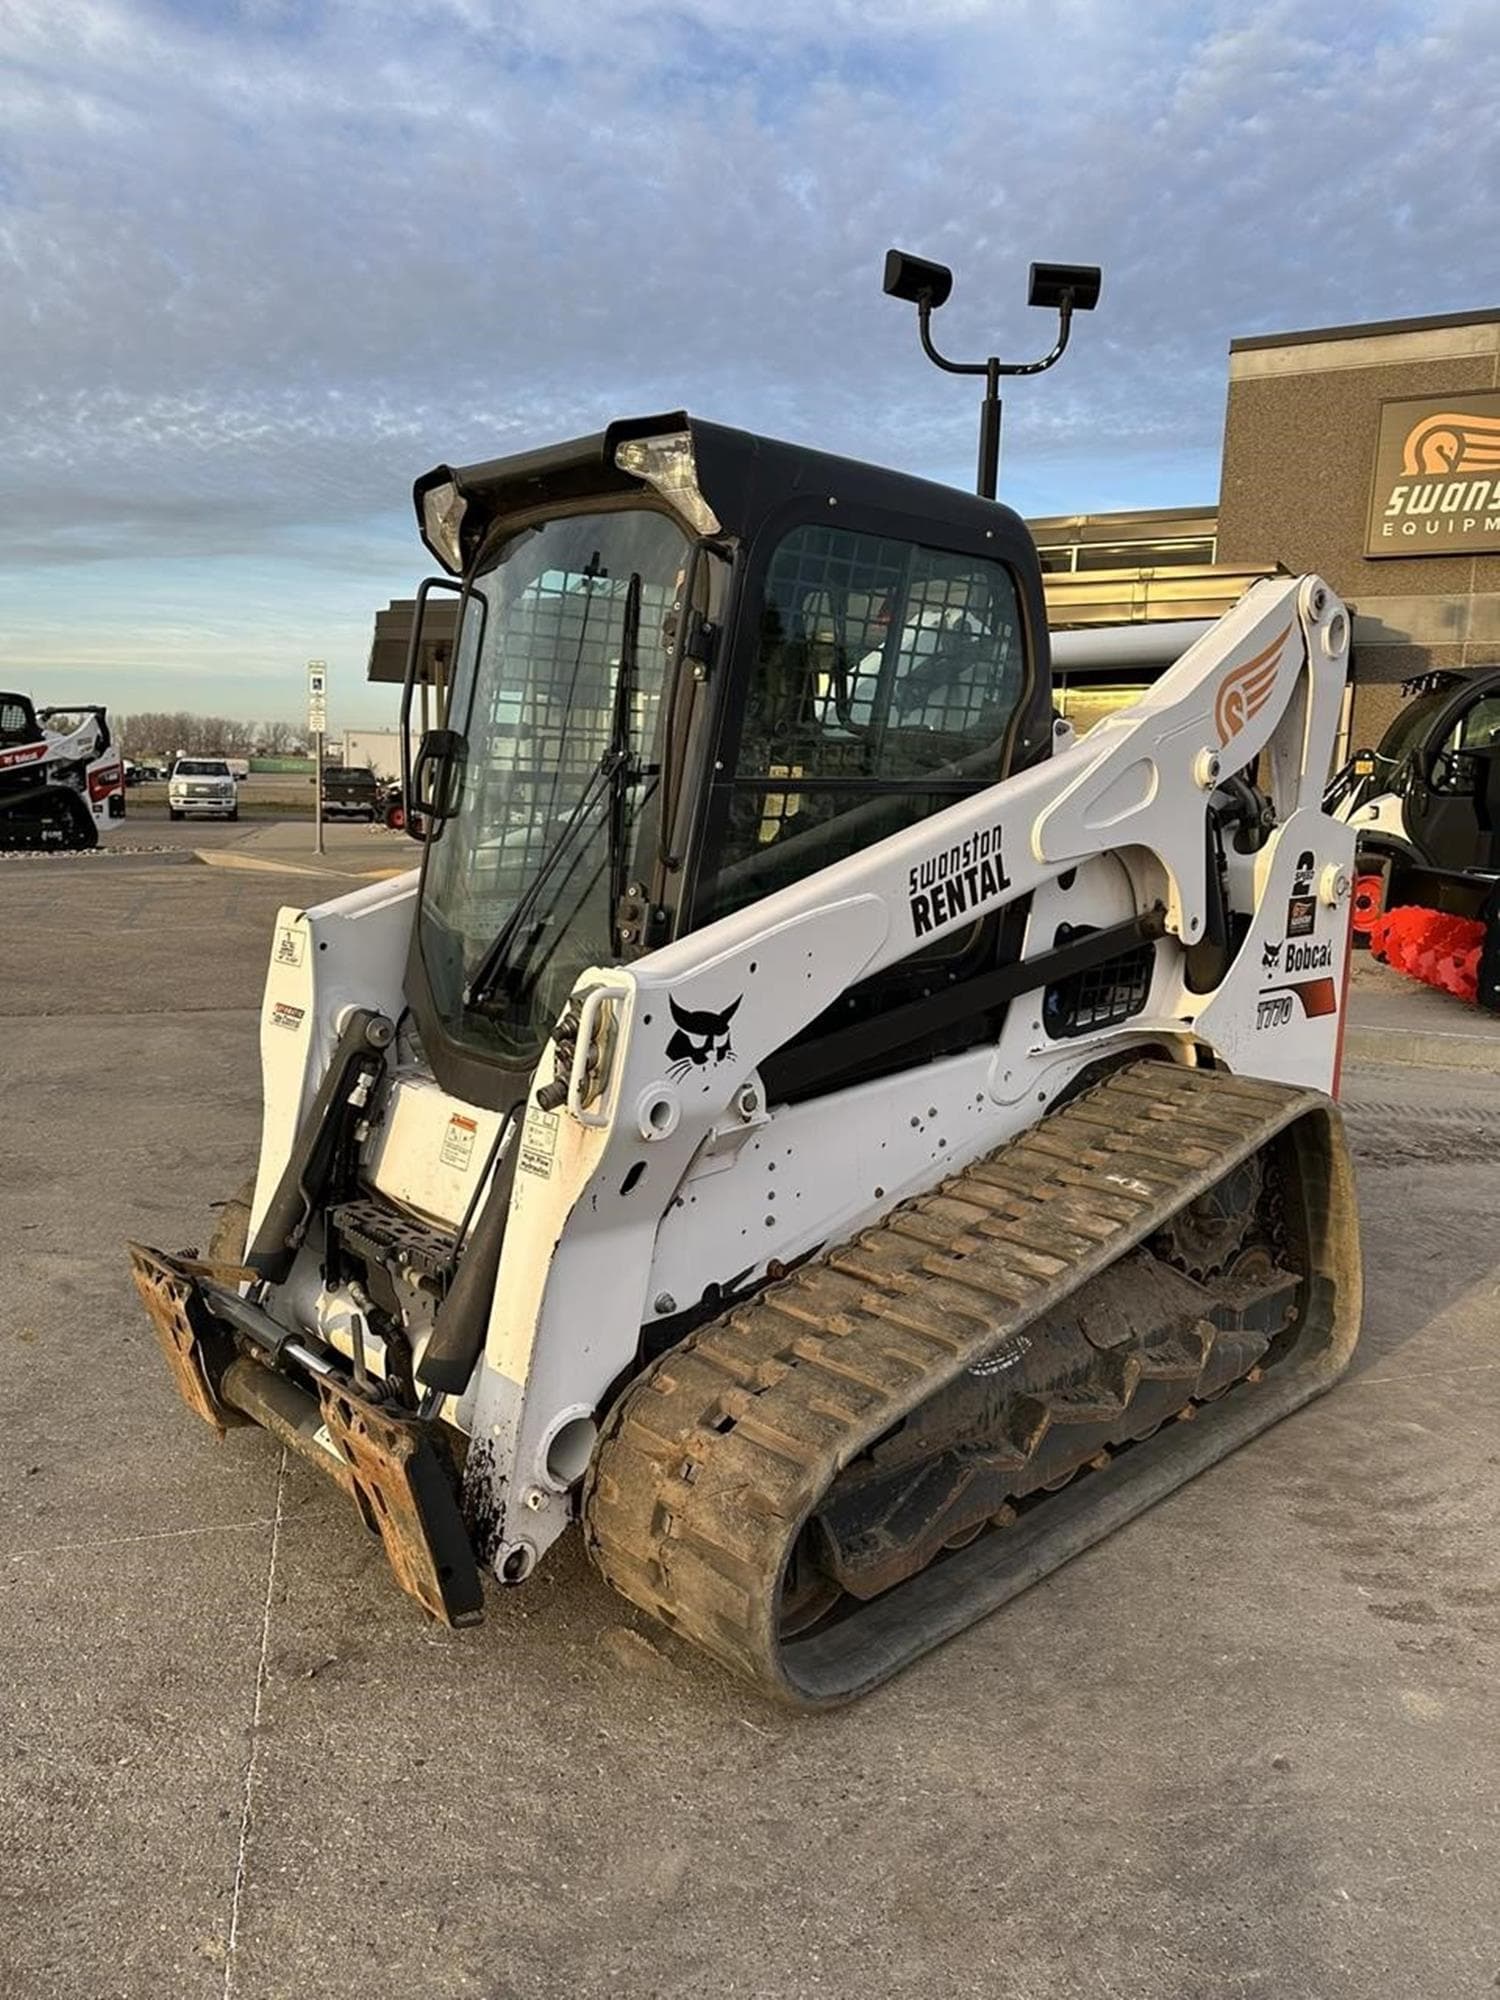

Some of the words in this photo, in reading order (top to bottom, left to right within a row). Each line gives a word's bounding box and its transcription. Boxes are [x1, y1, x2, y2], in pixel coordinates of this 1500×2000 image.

[1382, 517, 1500, 537] EQUIPM
[909, 824, 1002, 896] swanston
[910, 852, 1011, 938] RENTAL
[1285, 939, 1332, 973] Bobcat
[1256, 996, 1293, 1030] T770
